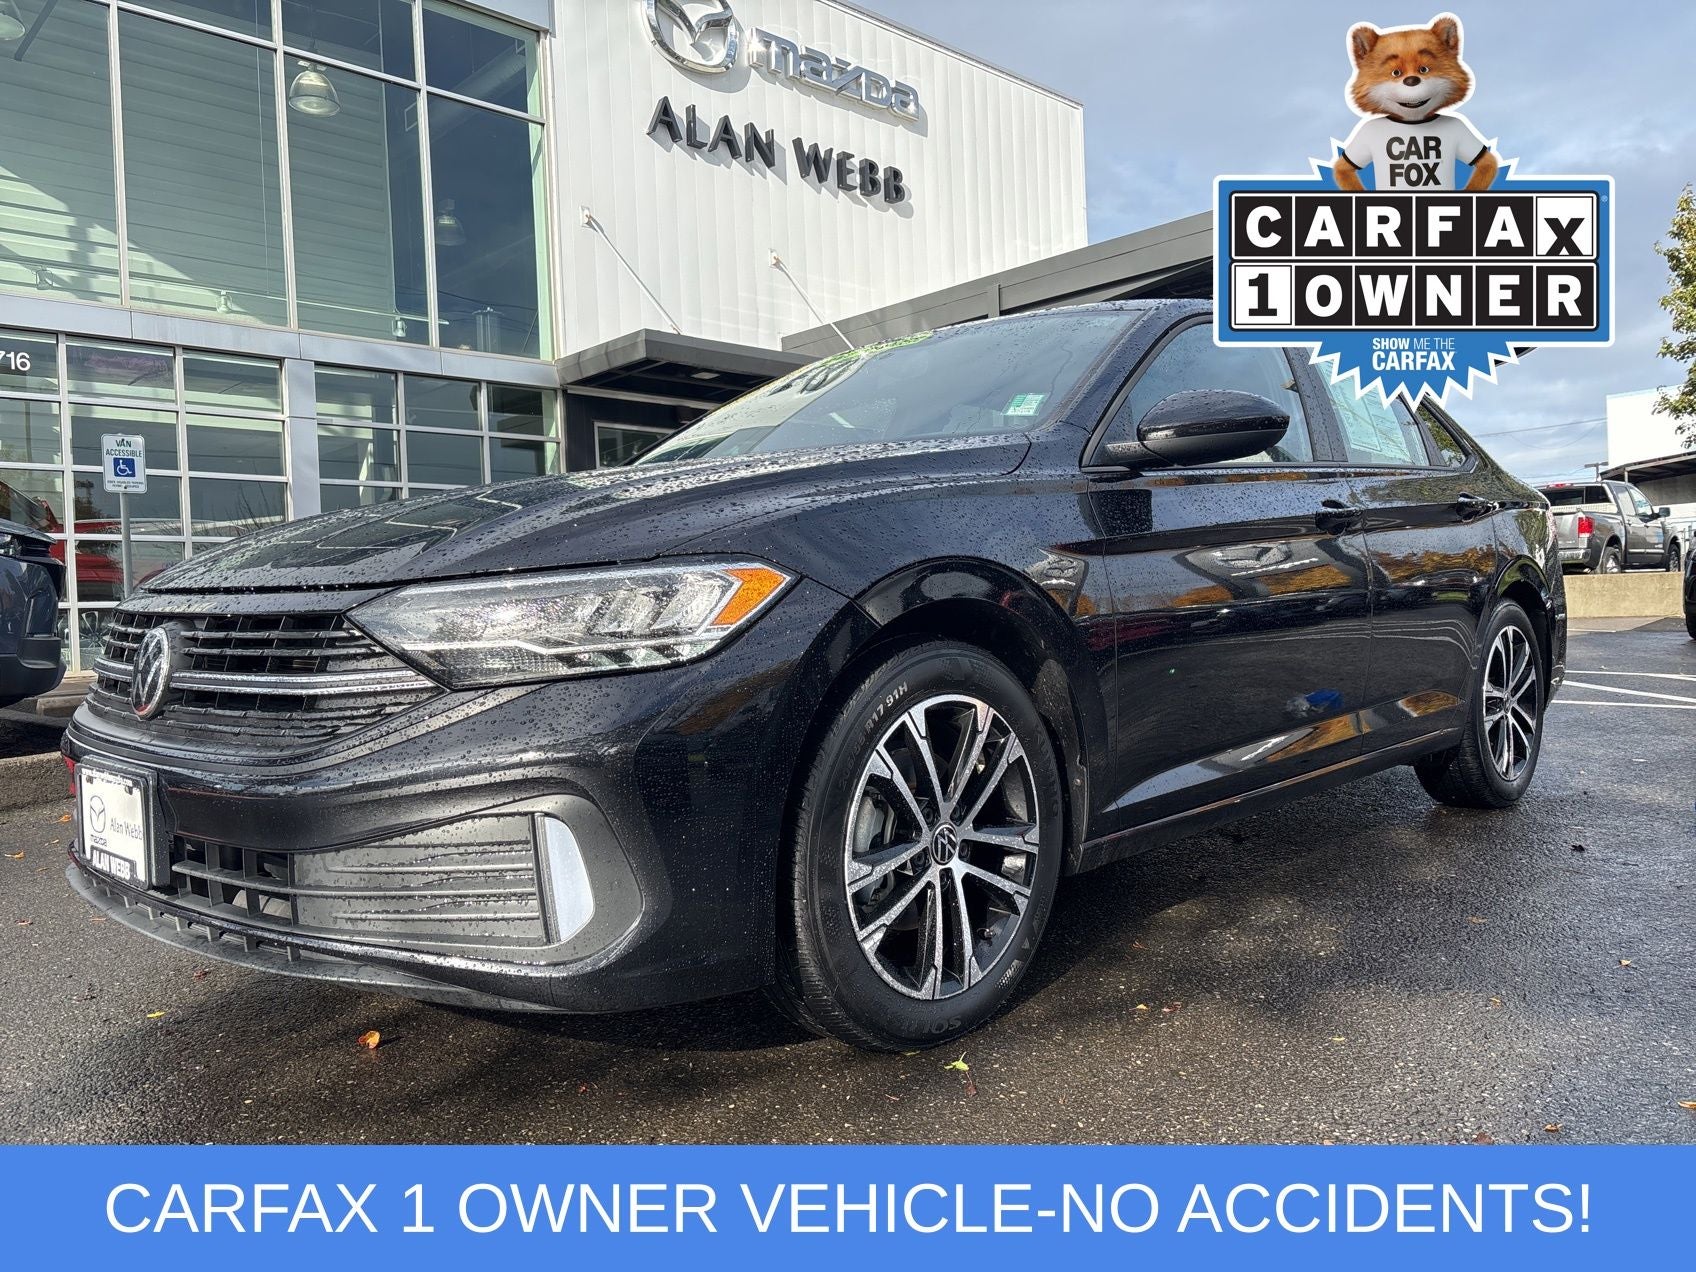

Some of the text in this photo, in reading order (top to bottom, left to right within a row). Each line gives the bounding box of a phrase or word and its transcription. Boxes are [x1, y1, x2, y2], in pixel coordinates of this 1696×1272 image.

[646, 96, 905, 203] ALAN WEBB
[105, 448, 143, 458] ACCESSIBLE
[115, 439, 132, 448] VAN
[864, 704, 884, 734] R17
[885, 682, 908, 707] 91H
[110, 817, 144, 841] Alan Webb
[92, 849, 131, 880] ALAN WEBB
